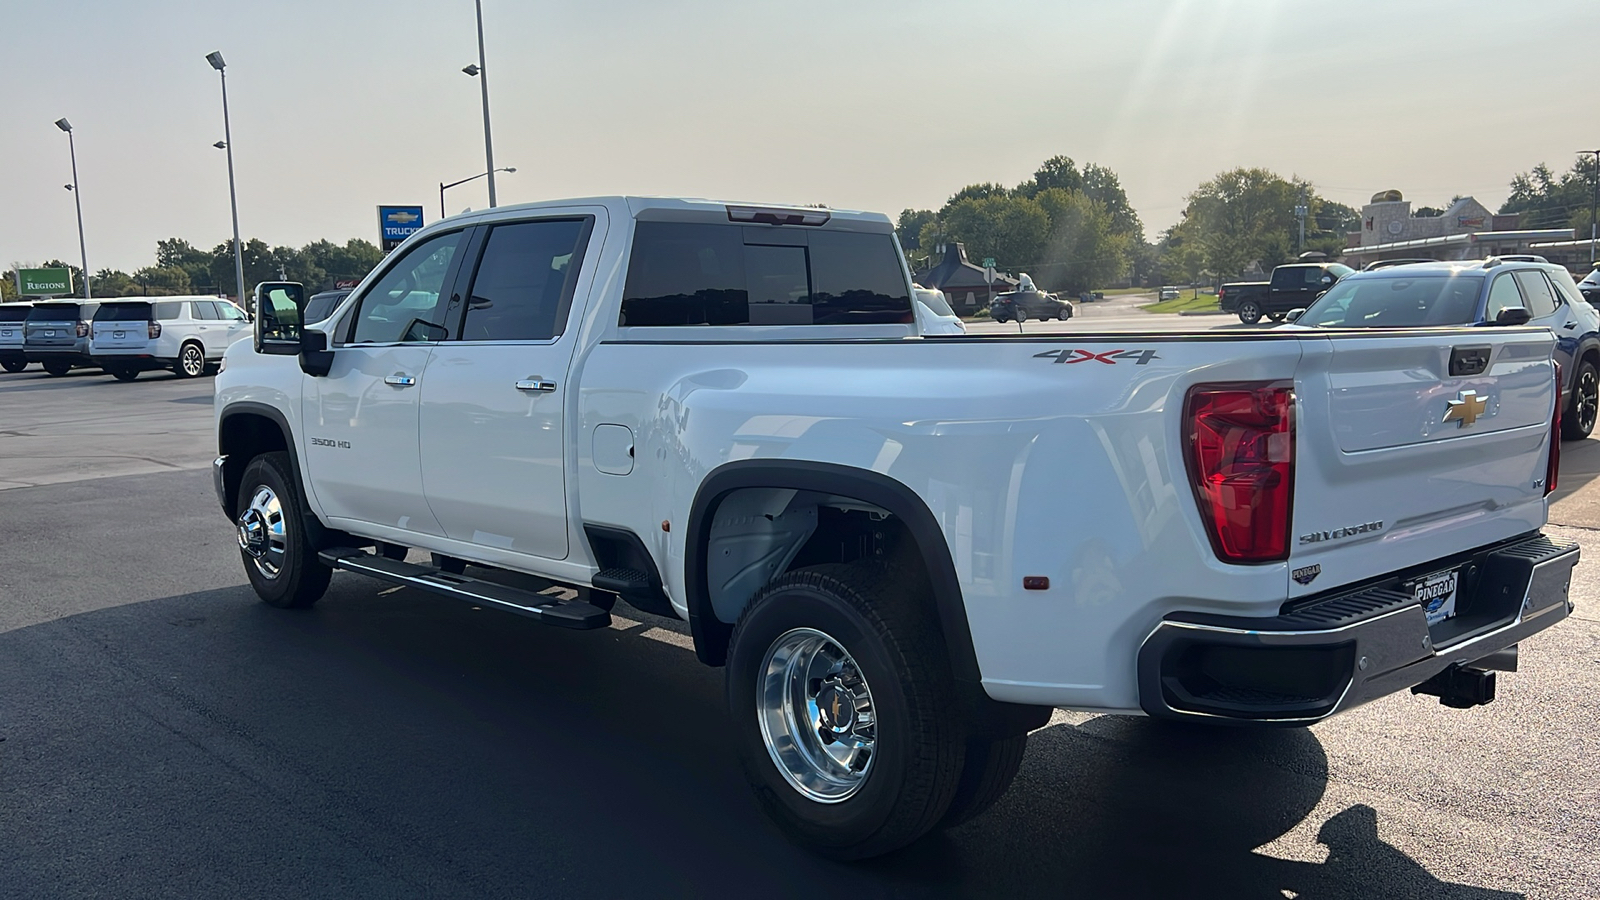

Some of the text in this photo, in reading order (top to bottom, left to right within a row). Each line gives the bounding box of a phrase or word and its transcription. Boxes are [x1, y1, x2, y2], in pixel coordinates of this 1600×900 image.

[311, 437, 351, 449] 3500 HD
[1299, 519, 1384, 545] SILVERADO
[1293, 564, 1321, 579] PINEGAR
[1417, 580, 1454, 601] PINEGAR
